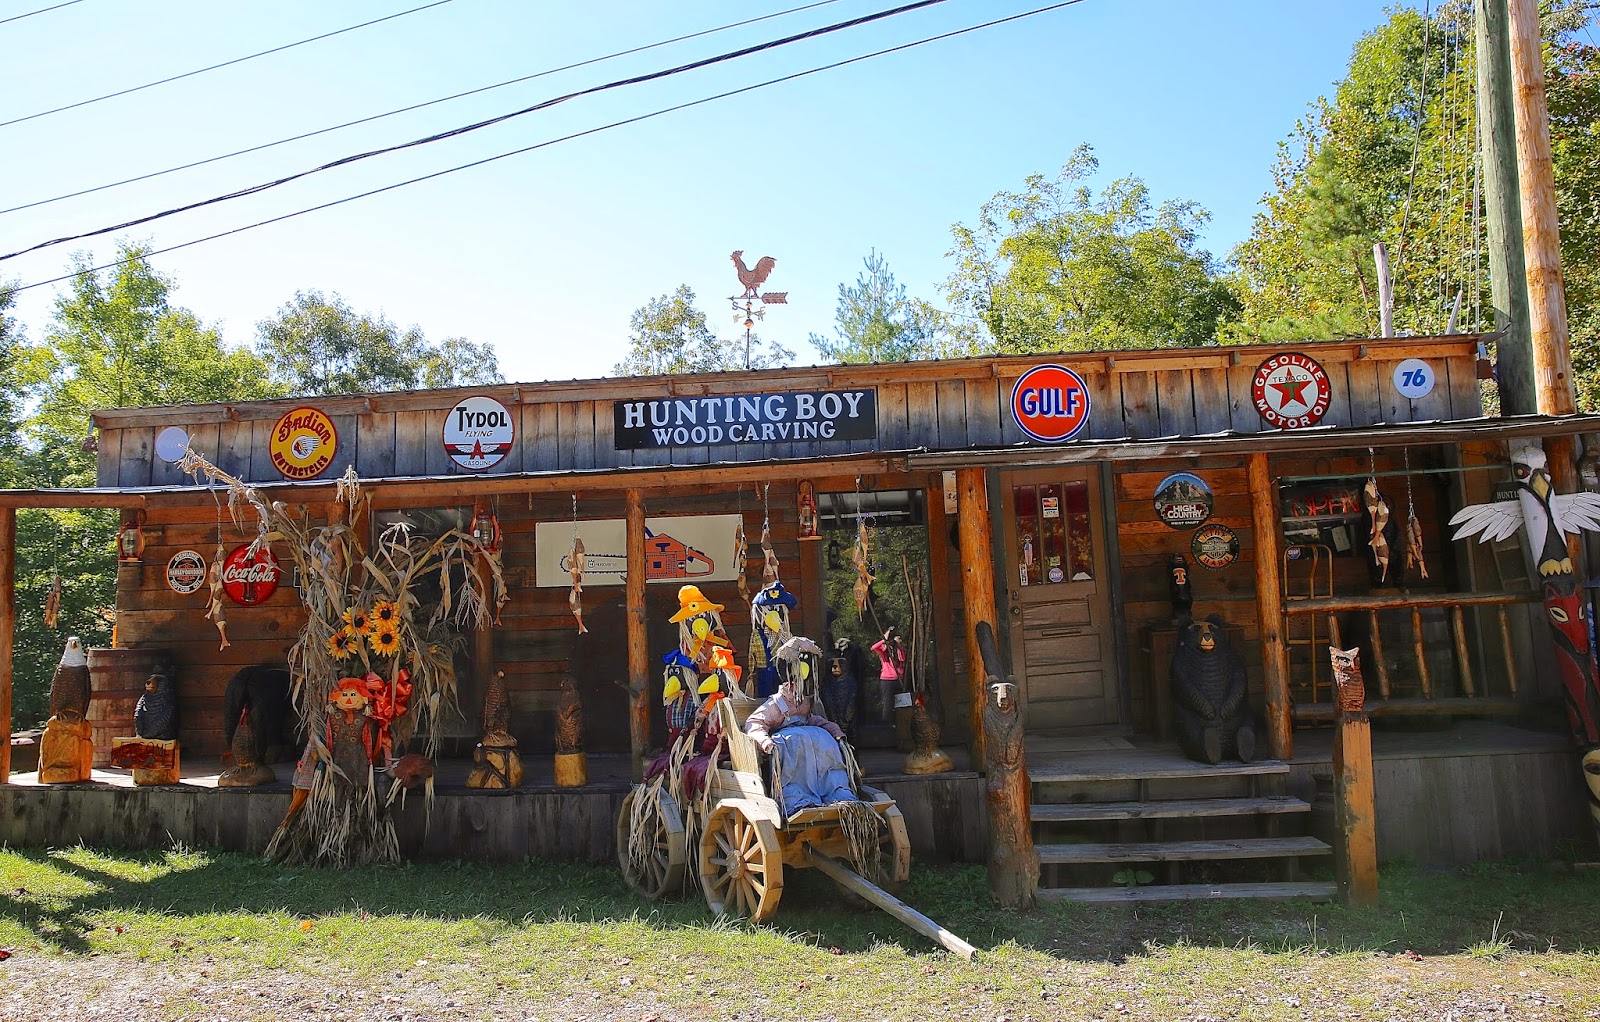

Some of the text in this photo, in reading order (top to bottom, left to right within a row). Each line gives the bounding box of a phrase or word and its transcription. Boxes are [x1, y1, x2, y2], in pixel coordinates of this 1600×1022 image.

[1255, 356, 1324, 387] GASOLINE
[1273, 374, 1308, 384] TEXACO
[1402, 368, 1426, 387] 76
[623, 392, 864, 429] HUNTING BOY
[1020, 387, 1082, 418] GULF
[1256, 398, 1311, 428] MOTOR
[1313, 391, 1328, 416] OIL
[278, 411, 332, 446] Indian
[456, 406, 508, 432] TYDOL
[465, 430, 493, 438] FLYING
[651, 420, 836, 446] WOOD CARVING
[273, 451, 329, 477] MOTORCYCLES
[1167, 509, 1203, 519] COUNTRY
[1172, 504, 1197, 512] HIGH
[1203, 556, 1230, 566] HARD
